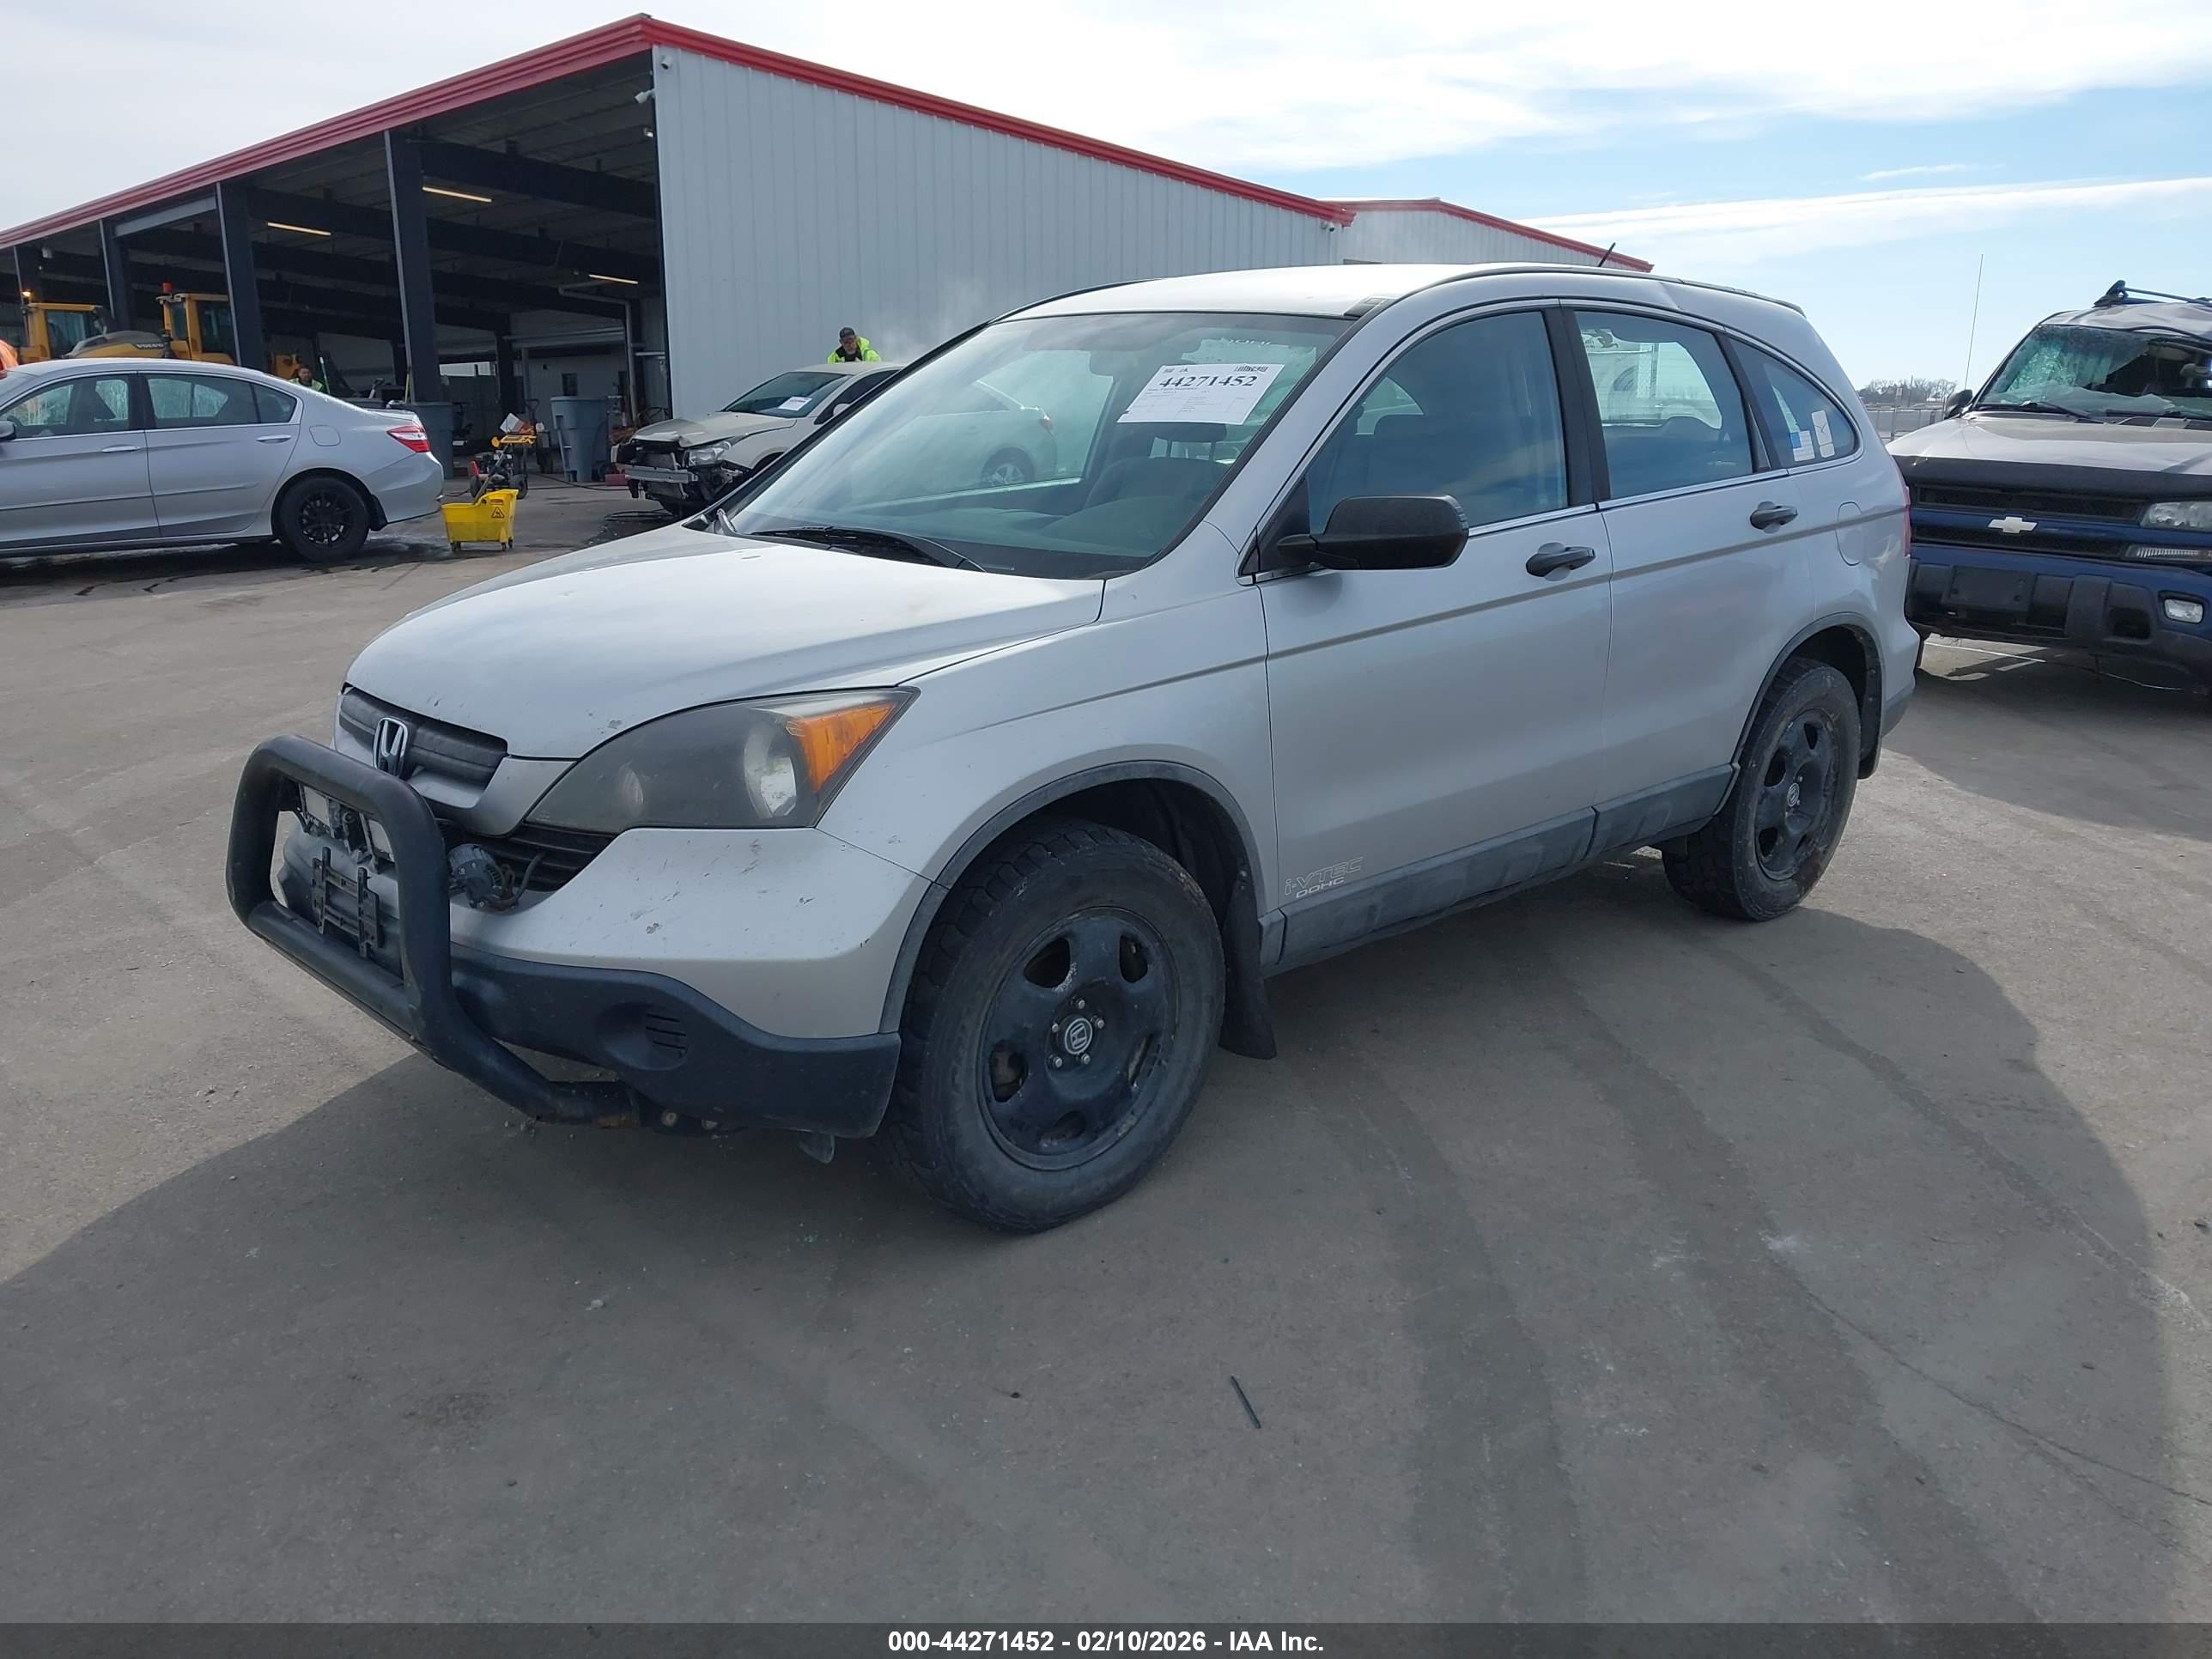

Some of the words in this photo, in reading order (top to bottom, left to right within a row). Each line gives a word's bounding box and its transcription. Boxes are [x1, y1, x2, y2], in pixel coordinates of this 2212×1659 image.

[1159, 375, 1258, 387] 44271452
[1284, 856, 1364, 896] i-VTEC
[1296, 877, 1346, 898] DOHC
